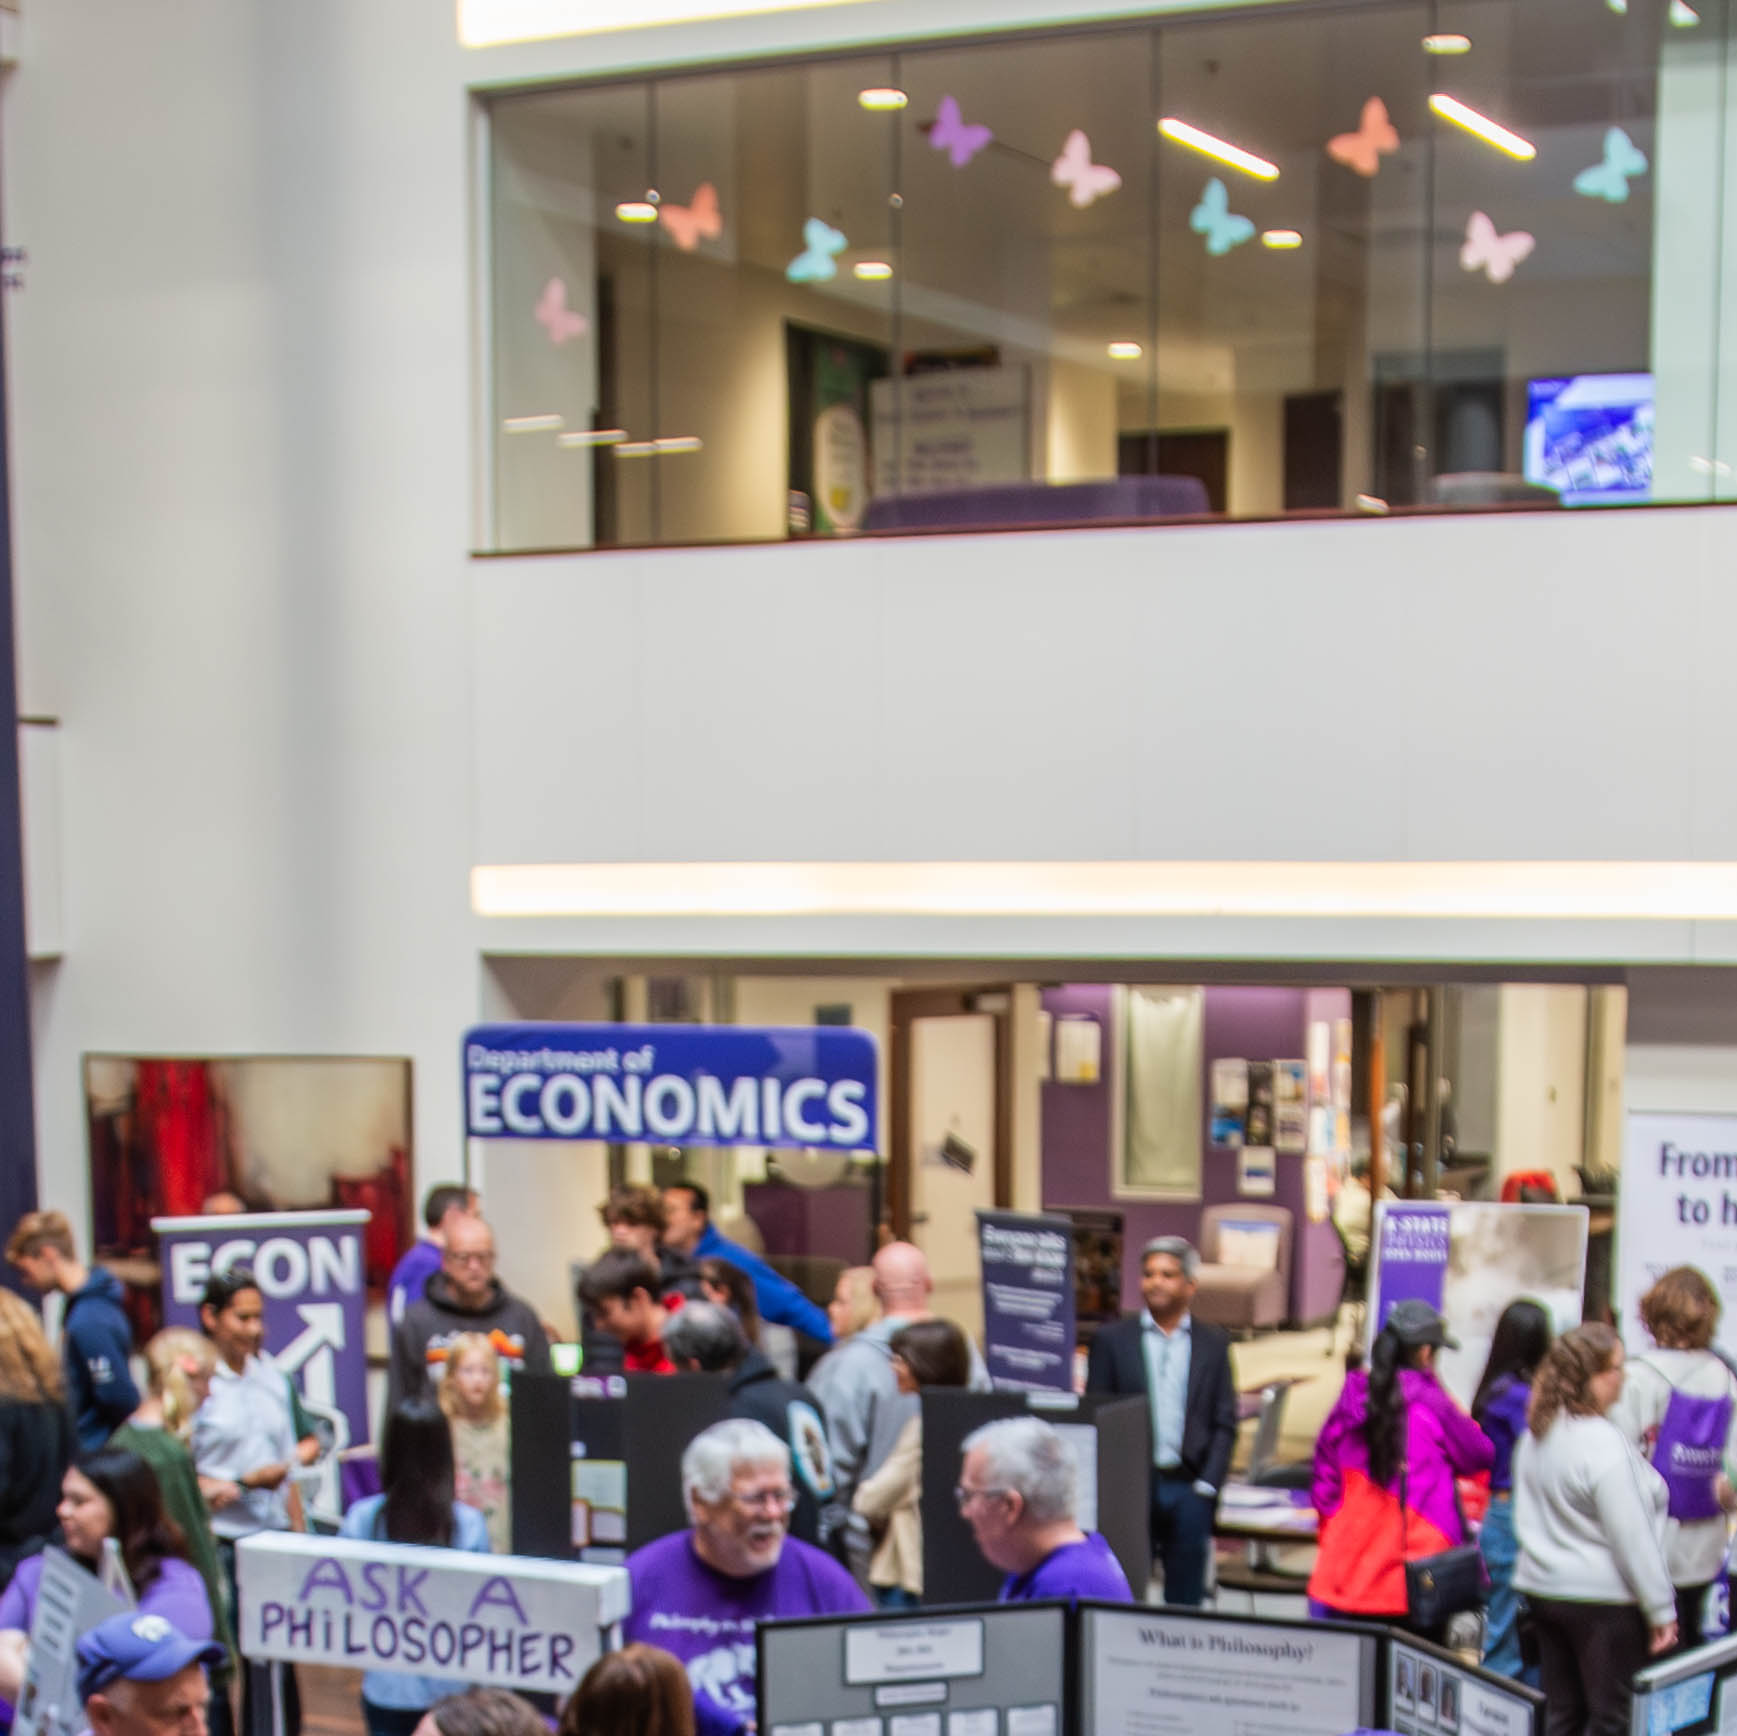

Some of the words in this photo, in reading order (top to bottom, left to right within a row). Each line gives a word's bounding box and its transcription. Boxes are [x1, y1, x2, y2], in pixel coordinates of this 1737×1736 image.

[468, 1043, 616, 1076] Department
[622, 1045, 653, 1073] of
[468, 1073, 869, 1145] ECONOMICS
[1677, 1193, 1711, 1227] to
[170, 1234, 360, 1304] ECON
[298, 1557, 432, 1619] ASK
[469, 1575, 531, 1627] A
[1138, 1628, 1187, 1648] What
[1191, 1634, 1206, 1650] is
[1207, 1635, 1315, 1664] Philosophy?
